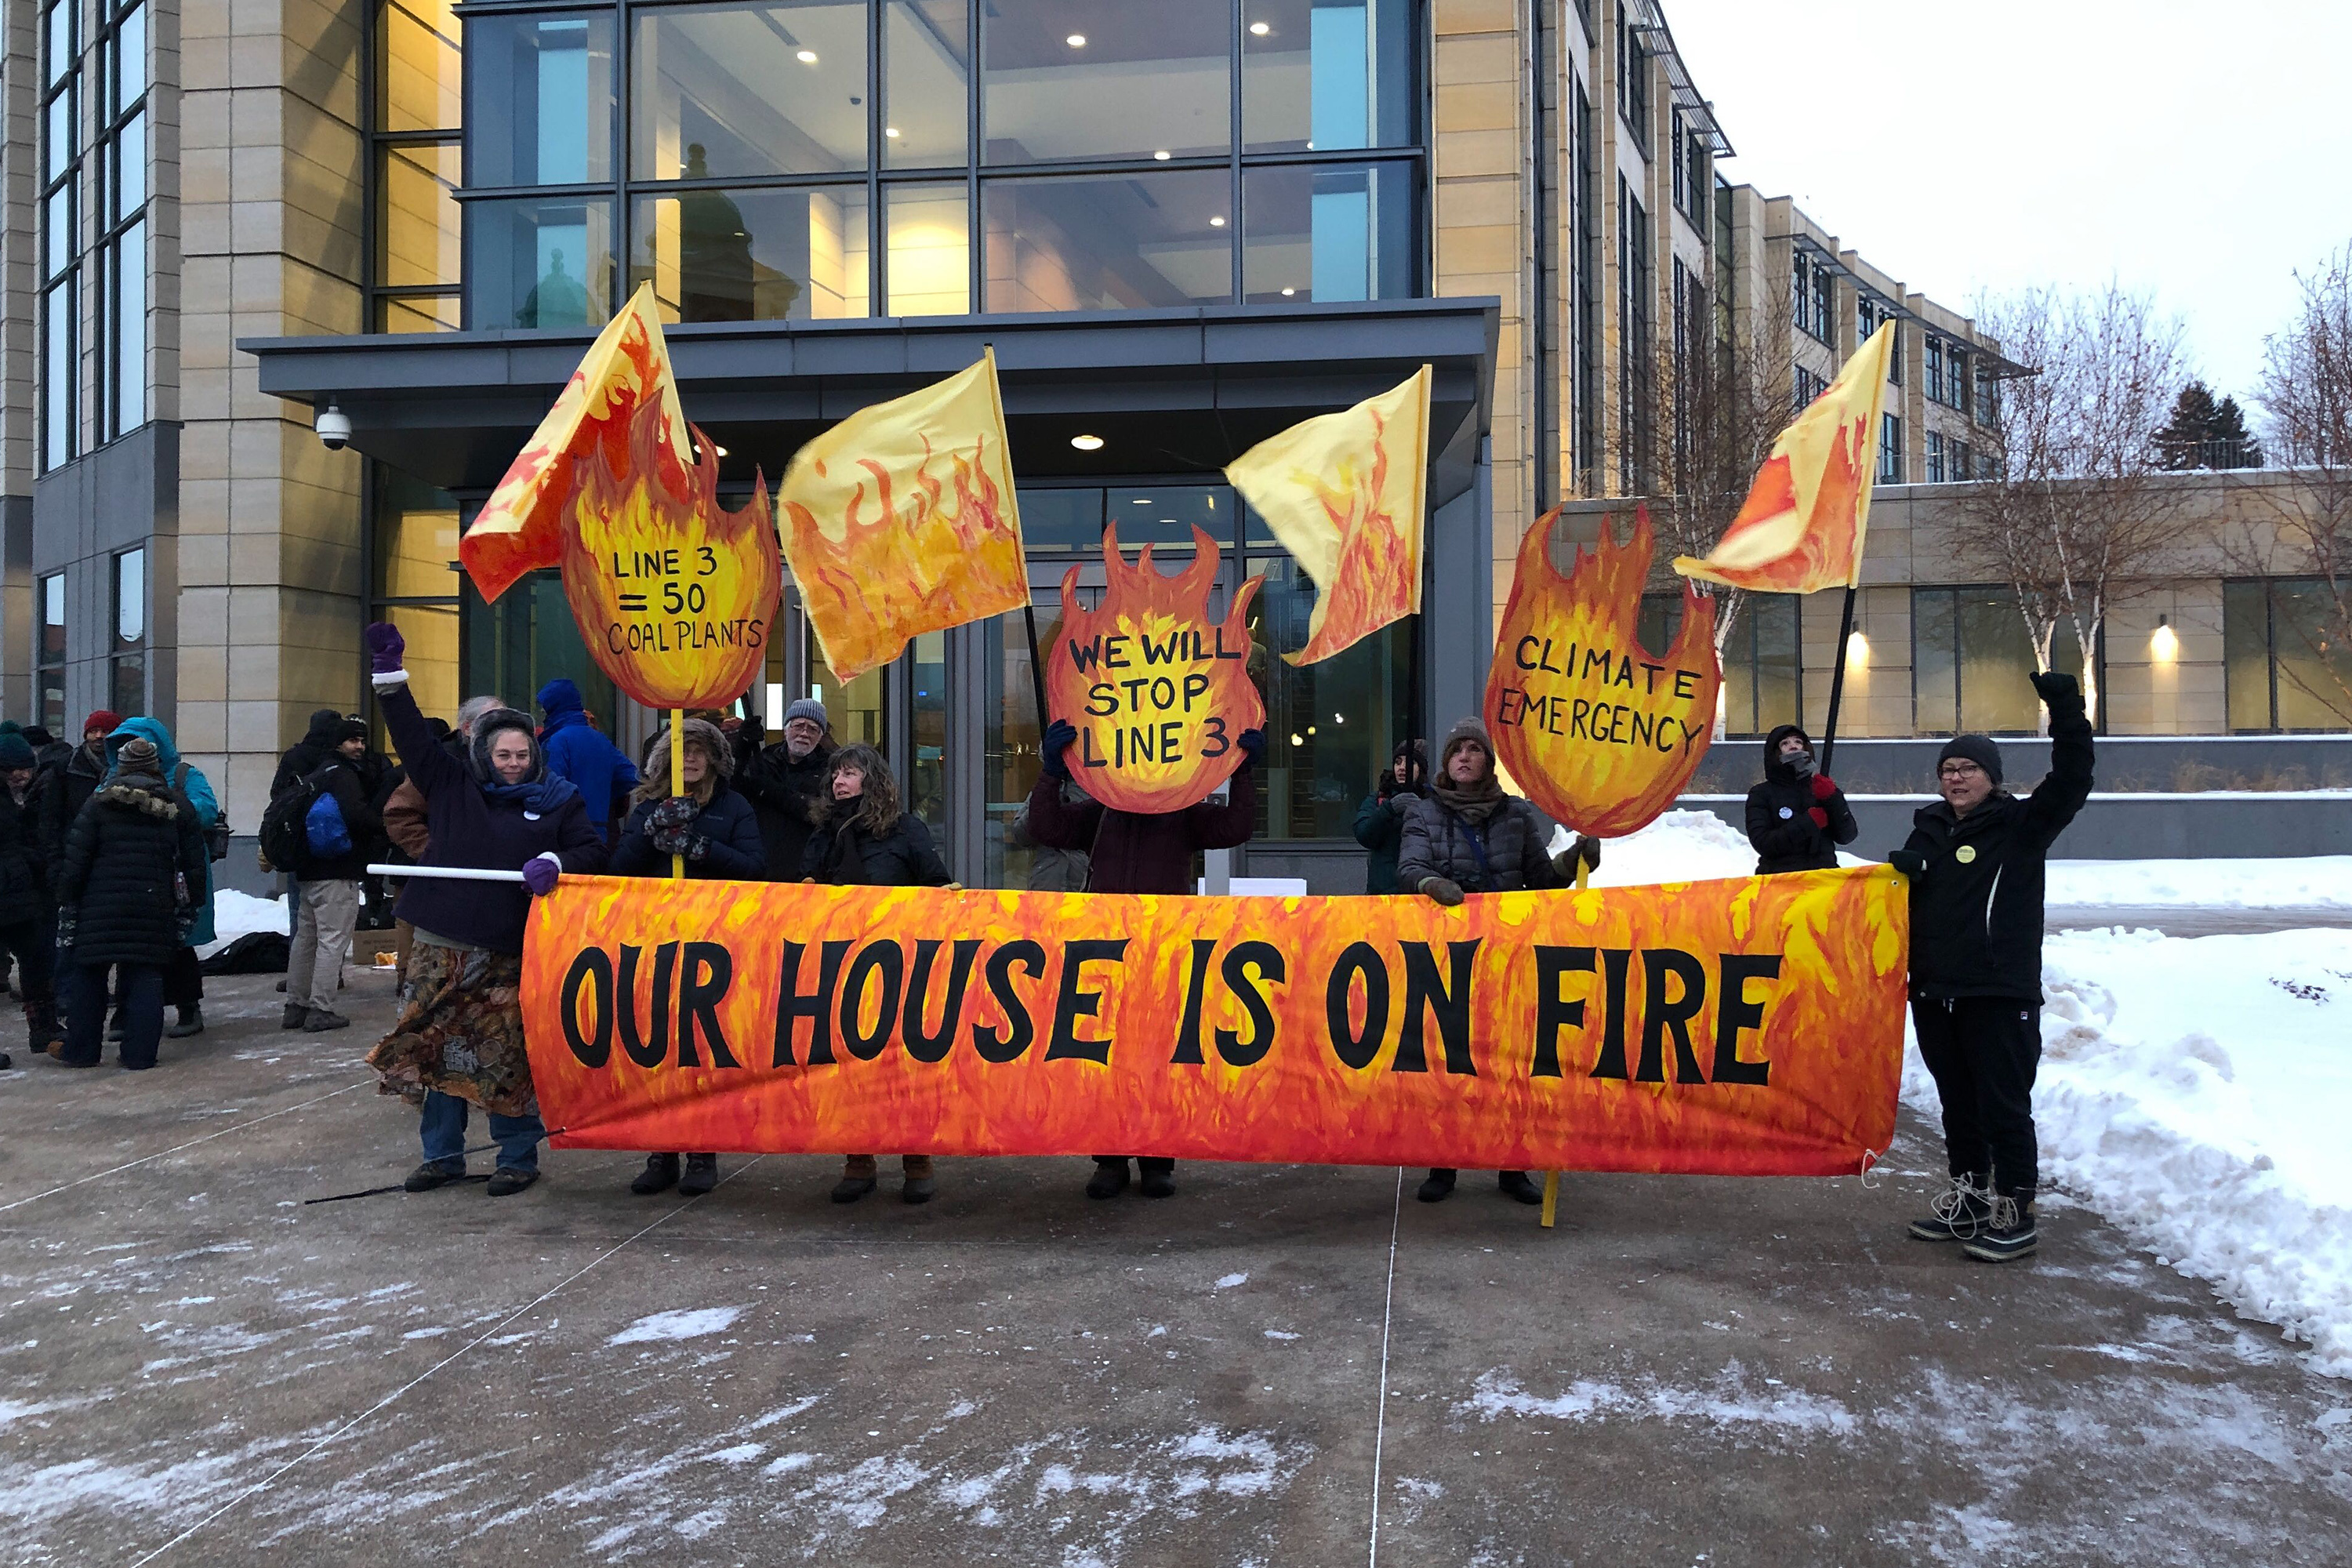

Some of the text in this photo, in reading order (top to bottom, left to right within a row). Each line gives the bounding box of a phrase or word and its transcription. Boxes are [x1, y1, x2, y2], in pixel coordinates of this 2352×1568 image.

[614, 547, 717, 578] LINE 3
[619, 583, 705, 614] = 50
[608, 619, 764, 655] COAL PLANTS
[1069, 627, 1241, 673] WE WILL
[1515, 635, 1702, 699] CLIMATE
[1084, 674, 1209, 716] STOP
[1083, 717, 1229, 768] LINE 3
[1498, 688, 1704, 757] EMERGENCY
[561, 938, 1783, 1086] OUR HOUSE IS ON FIRE
